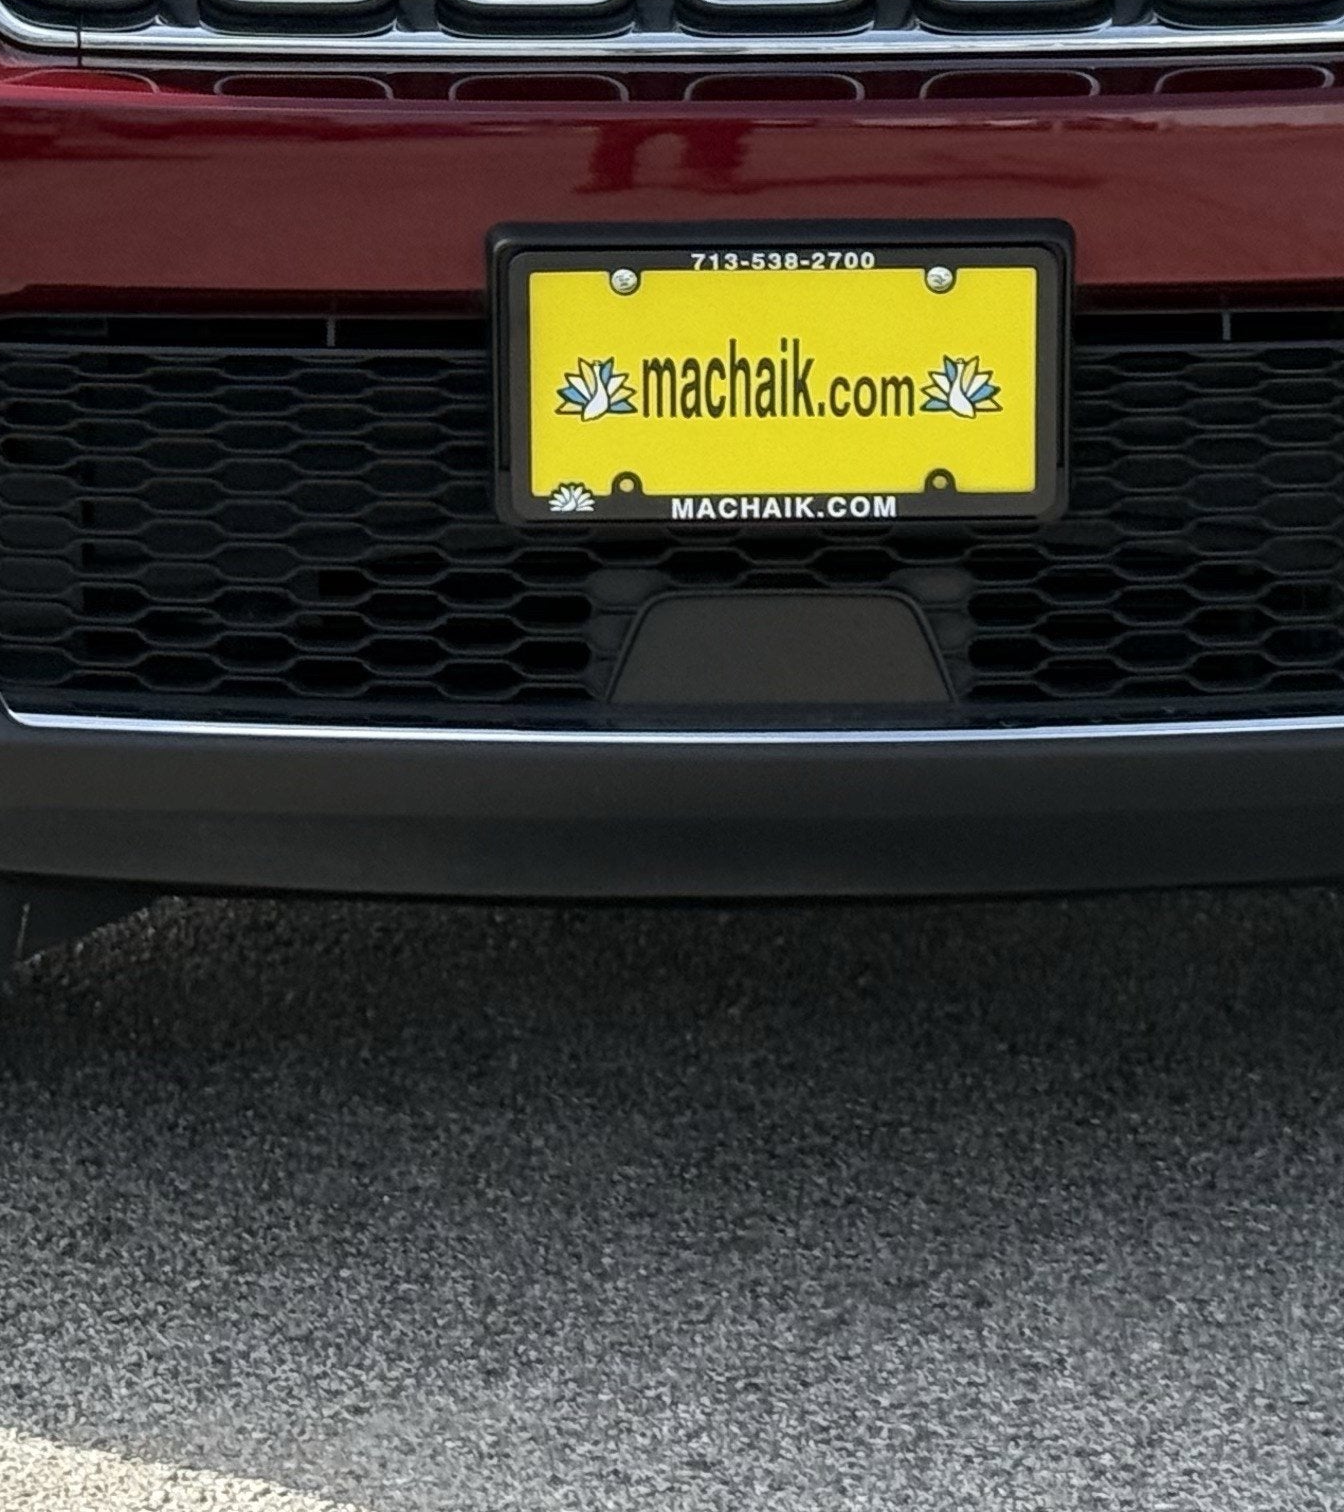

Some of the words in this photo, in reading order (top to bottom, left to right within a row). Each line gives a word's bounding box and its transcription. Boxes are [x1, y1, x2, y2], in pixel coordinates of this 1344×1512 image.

[690, 251, 876, 271] 713-538-2700
[641, 337, 916, 419] machaik.com
[671, 495, 898, 520] MACHAIK.COM
